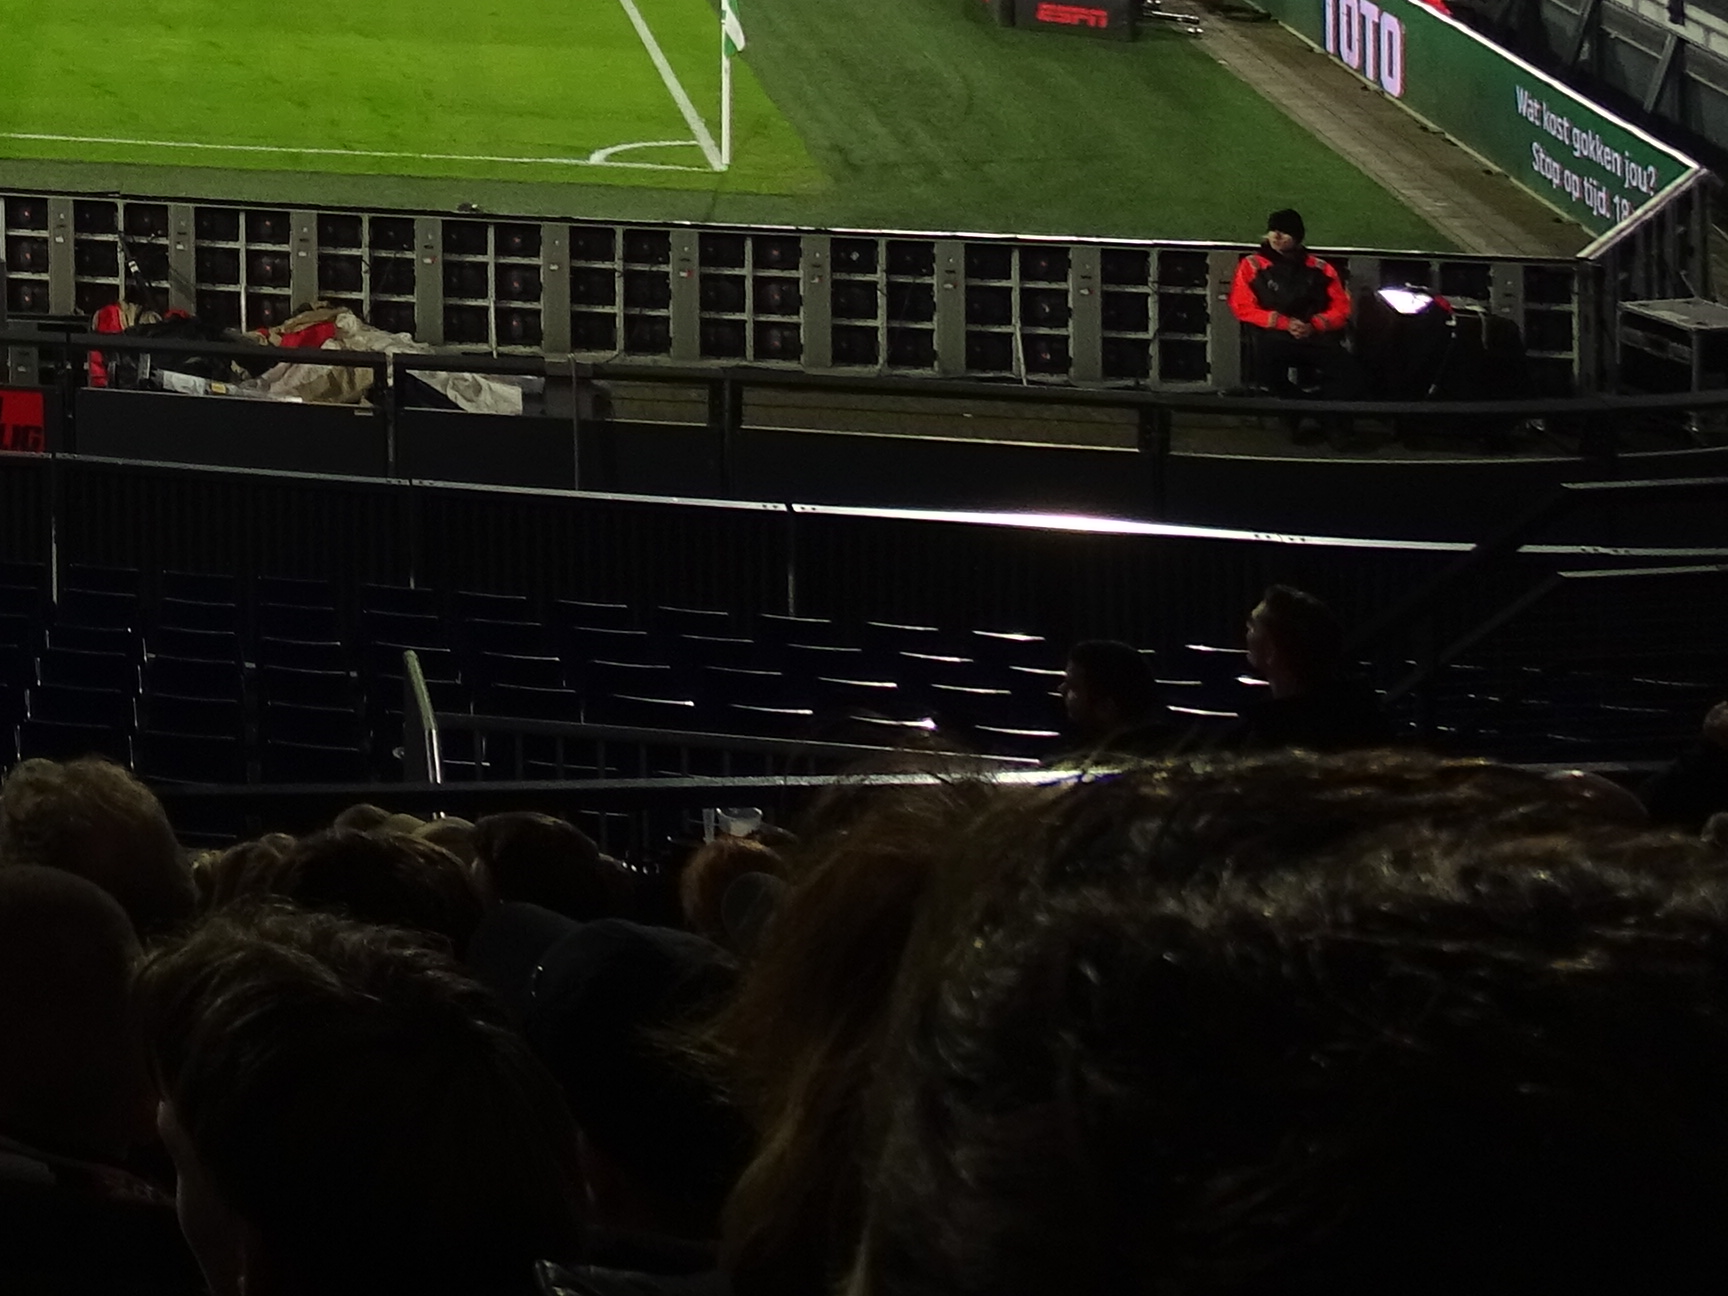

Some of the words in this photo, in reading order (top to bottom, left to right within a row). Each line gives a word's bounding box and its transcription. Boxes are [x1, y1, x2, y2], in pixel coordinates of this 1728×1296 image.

[1035, 1, 1109, 29] ESPN
[1516, 84, 1542, 127] Wat
[1542, 102, 1570, 146] kost
[1572, 127, 1623, 178] gokken
[1624, 151, 1658, 196] jou?
[1532, 142, 1562, 189] Stop
[1564, 169, 1583, 202] op
[1583, 177, 1612, 219] tijd.
